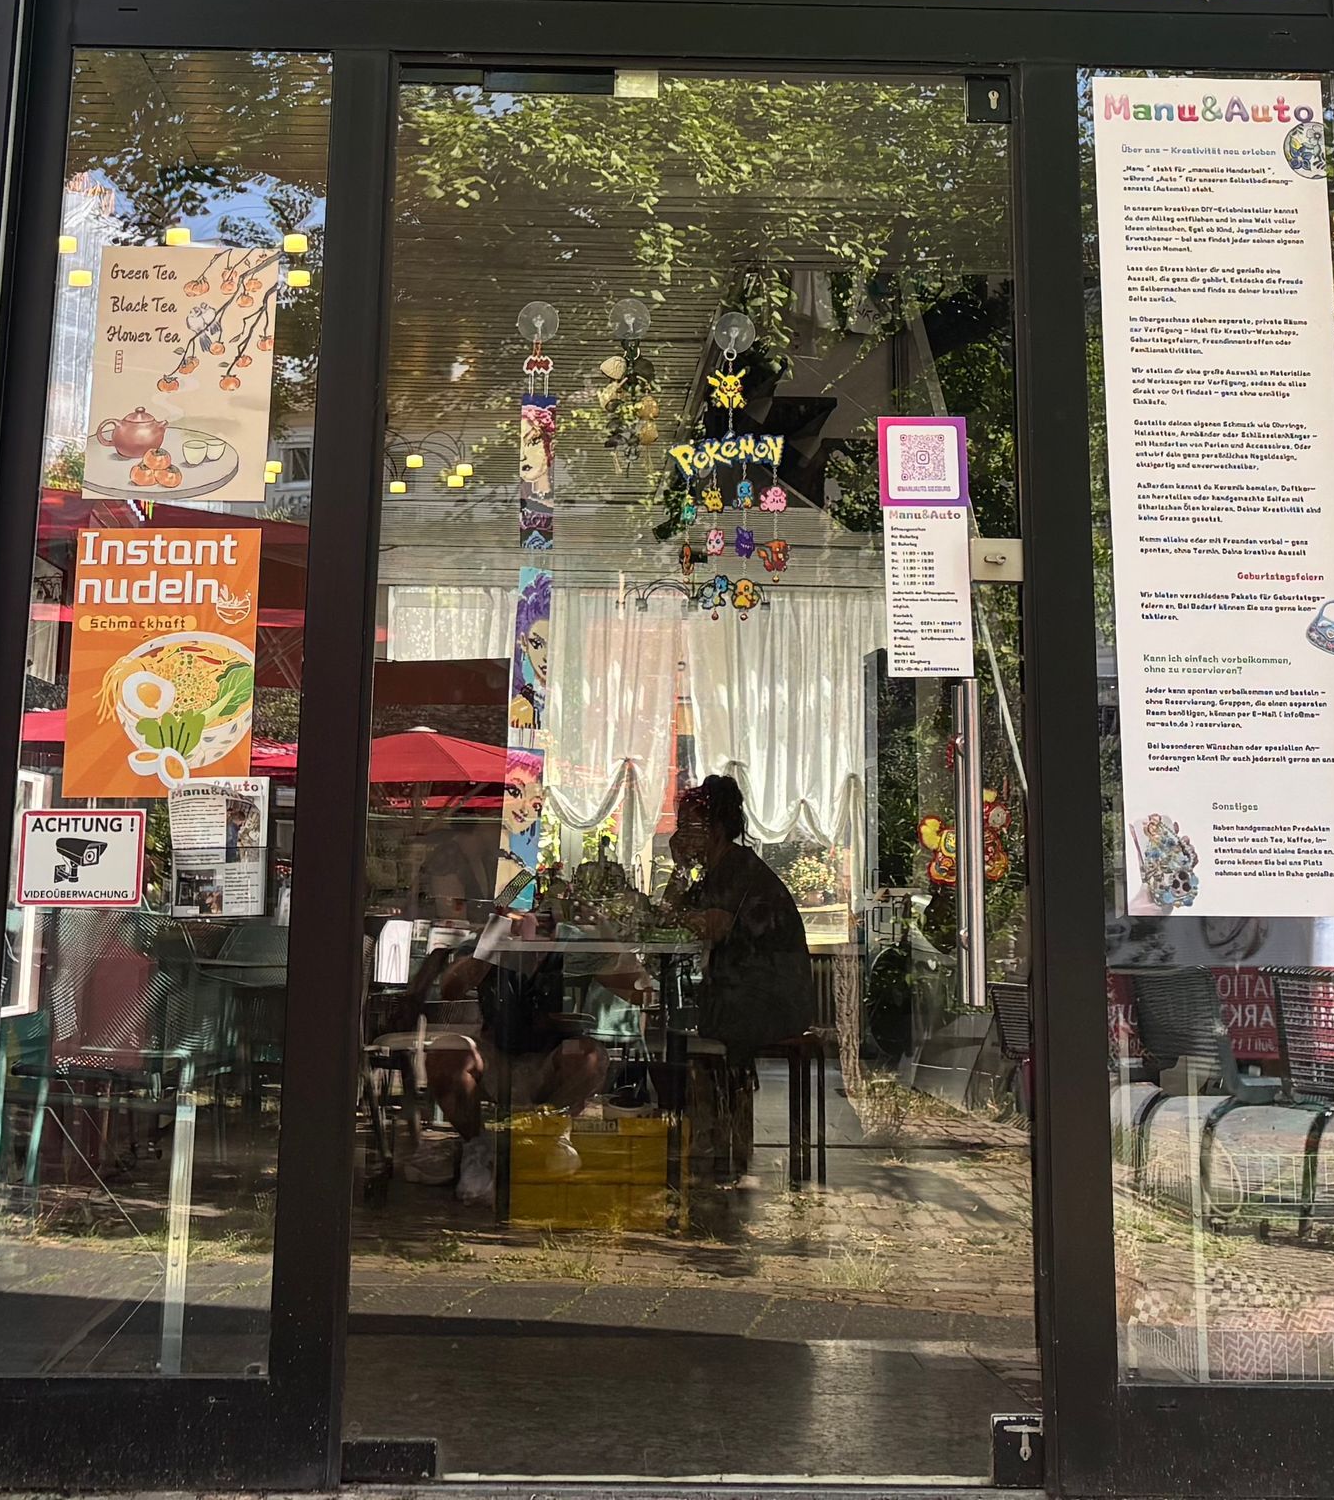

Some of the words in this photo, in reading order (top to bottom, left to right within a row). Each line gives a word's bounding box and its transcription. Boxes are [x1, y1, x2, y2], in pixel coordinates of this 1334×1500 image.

[1104, 93, 1314, 123] Manu&Auto
[110, 264, 149, 281] Green
[153, 264, 177, 281] Tea
[110, 296, 149, 313] Black
[151, 298, 177, 313] Tea
[106, 327, 152, 344] Flower
[155, 327, 181, 344] Tea
[889, 509, 961, 520] Manu&Auto
[79, 531, 238, 566] Instant
[78, 570, 219, 605] nudeln
[89, 617, 186, 631] Schmackhaft
[1143, 653, 1167, 663] Kann
[1167, 654, 1183, 663] ich
[1184, 654, 1219, 664] einfach
[1221, 655, 1292, 666] vorbeikommen,
[1143, 664, 1166, 674] ohne
[1181, 665, 1243, 675] reservieren?
[1211, 801, 1259, 813] Sonstiges
[31, 817, 123, 834] ACHTUNG
[130, 817, 135, 833] !
[23, 887, 128, 900] VIDEOÜBERWACHUNG
